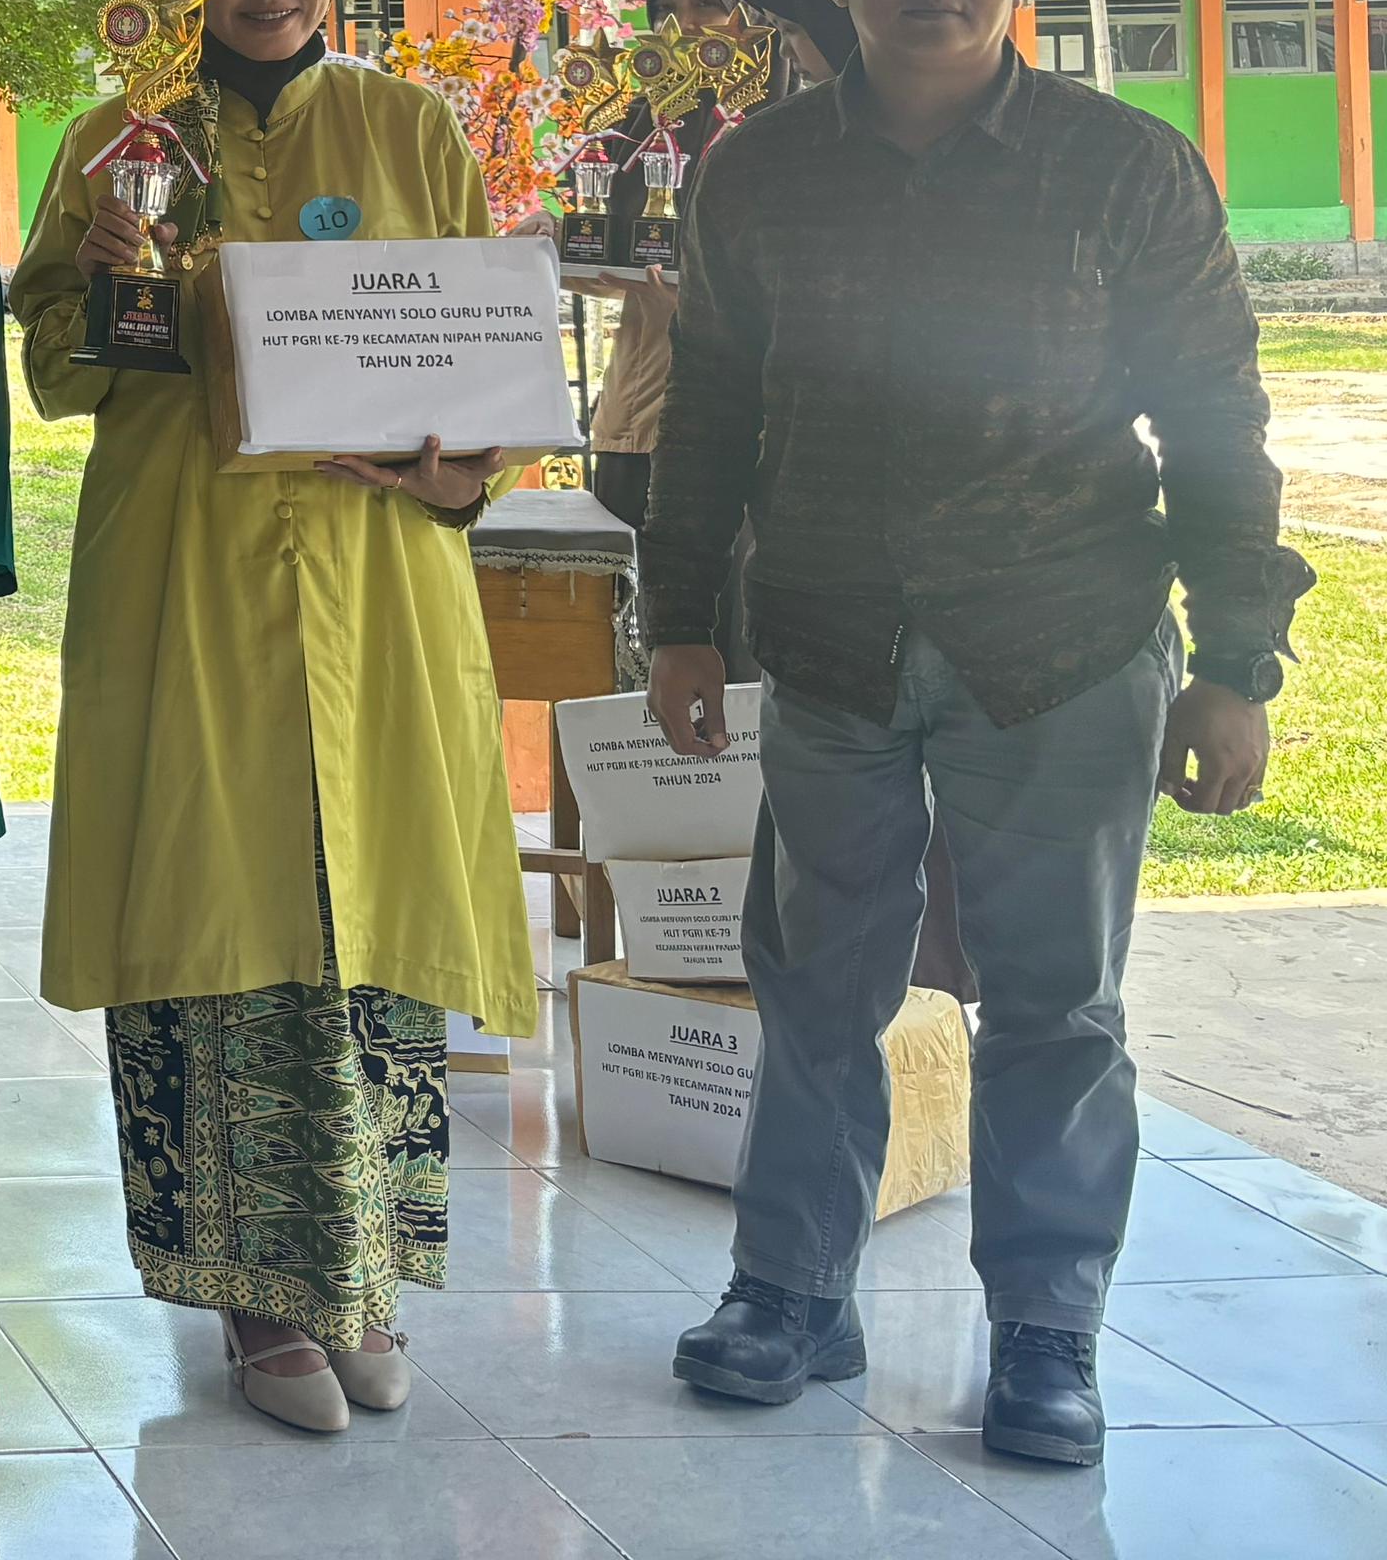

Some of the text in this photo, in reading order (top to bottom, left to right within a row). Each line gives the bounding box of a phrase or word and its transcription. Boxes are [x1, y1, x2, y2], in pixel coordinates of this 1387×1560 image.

[314, 210, 348, 231] 10
[351, 271, 440, 290] JUARA 1
[266, 305, 532, 321] LOMBA MENYANYI SOLO GURU PUTRA
[262, 331, 542, 346] HUT PGRI KE-79 KECAMATAN NIPAH PANJANG
[356, 354, 453, 368] TAHUN 2024
[589, 741, 624, 752] LOMBA
[627, 737, 669, 749] MENYAN
[586, 762, 604, 771] HUT
[606, 761, 627, 770] PGRI
[628, 759, 653, 769] KE-79
[652, 772, 721, 786] TAHUN 2024
[657, 886, 721, 902] JUARA 2
[663, 927, 730, 937] HUT PGRI KE-79
[669, 1024, 737, 1050] JUARA 3
[607, 1042, 753, 1080] LOMBA MENYANYI SOLO GU
[601, 1062, 751, 1100] HUT PGRI KE-79 KECAMATAN NIP
[668, 1093, 741, 1117] TAHUN 2024
